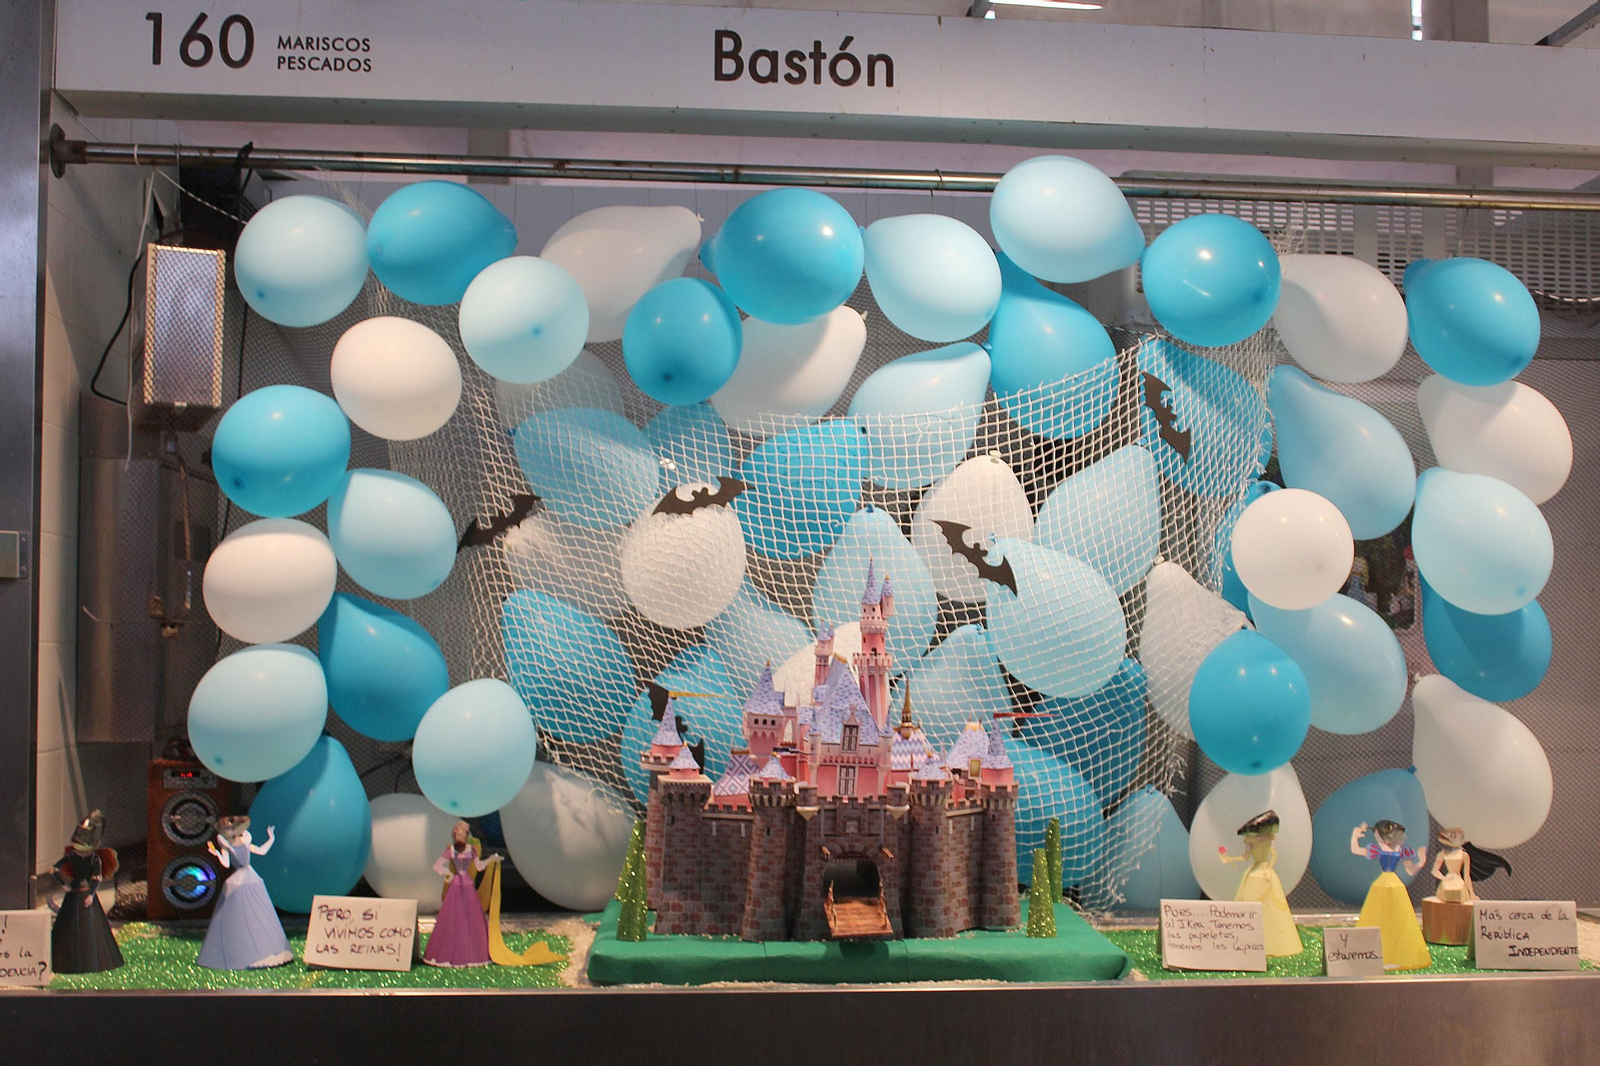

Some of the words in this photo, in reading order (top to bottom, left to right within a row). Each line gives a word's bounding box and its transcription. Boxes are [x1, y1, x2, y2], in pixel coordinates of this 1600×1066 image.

[145, 12, 254, 69] 160
[277, 35, 371, 53] MARISCOS
[277, 56, 372, 72] PESCADOS
[714, 29, 894, 88] Bastón
[1508, 911, 1535, 920] cerca
[1541, 908, 1553, 921] de
[1558, 908, 1570, 921] la
[1165, 919, 1175, 929] al
[379, 926, 413, 939] COMO
[1167, 930, 1181, 939] las
[19, 946, 33, 958] la
[315, 943, 339, 954] LAS
[350, 942, 401, 962] REINAS!
[1167, 941, 1203, 951] tenemos
[1212, 941, 1227, 950] los
